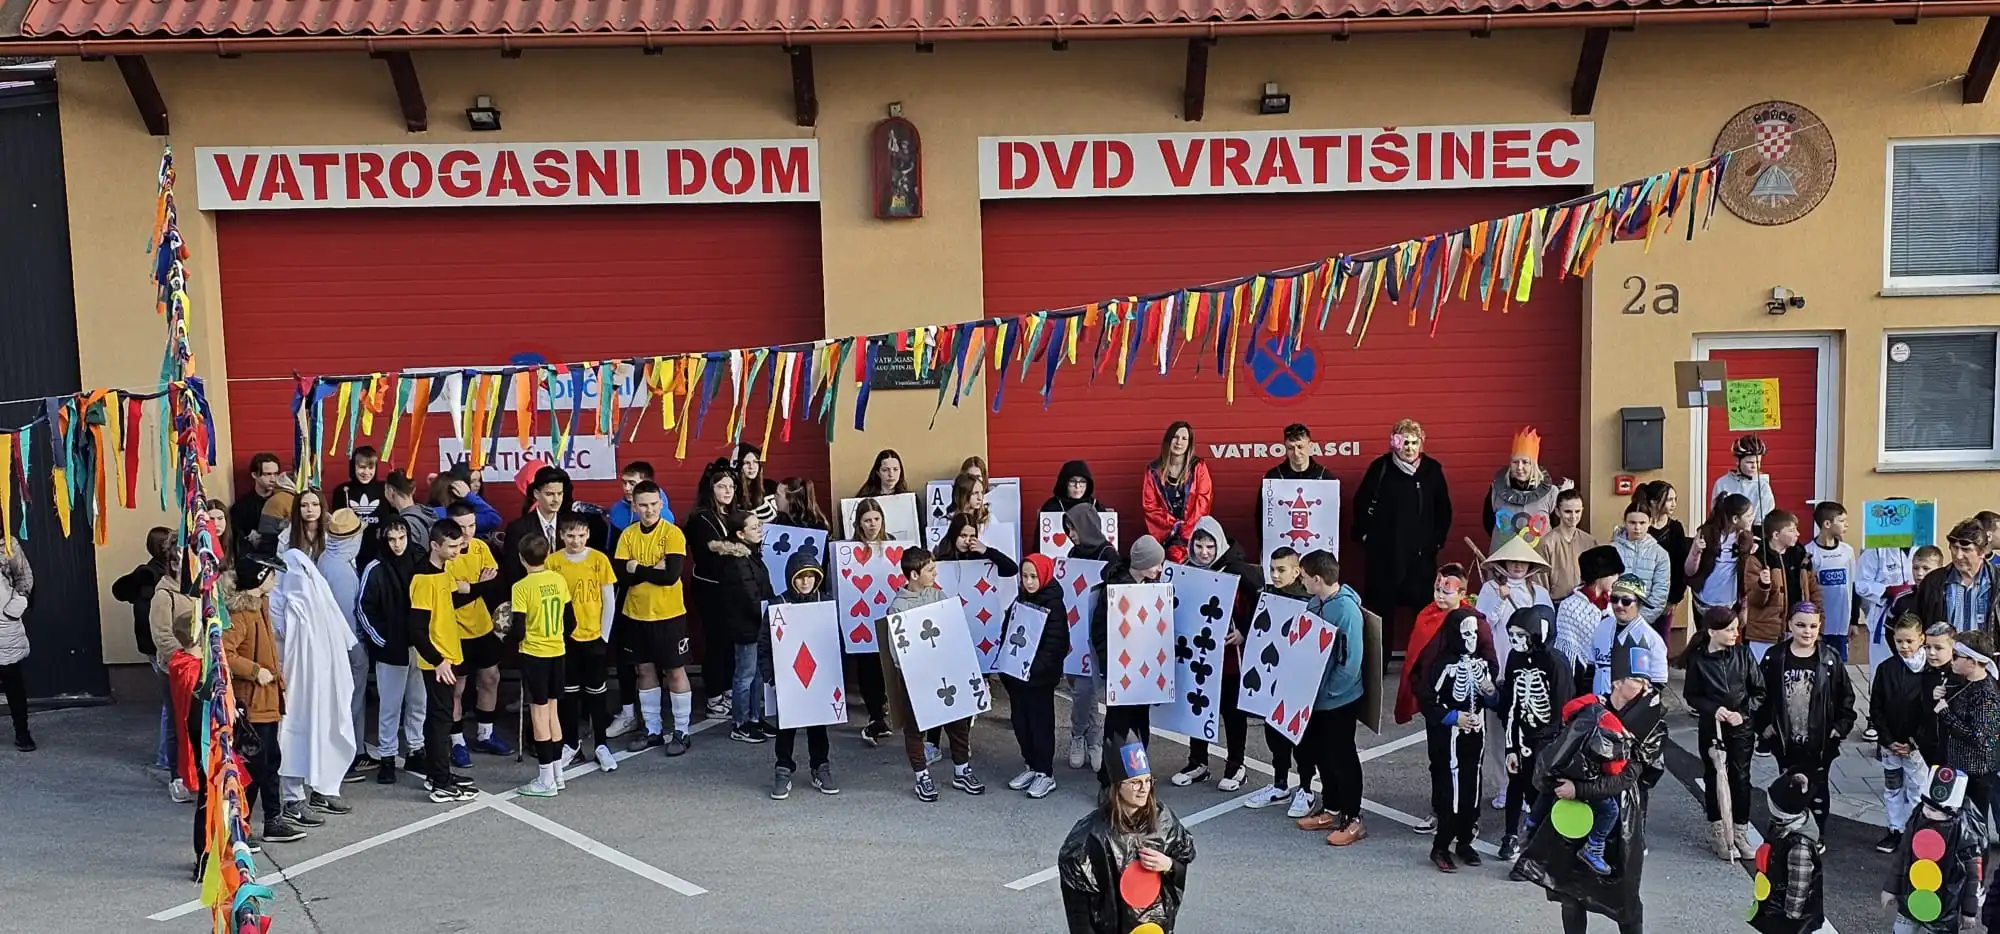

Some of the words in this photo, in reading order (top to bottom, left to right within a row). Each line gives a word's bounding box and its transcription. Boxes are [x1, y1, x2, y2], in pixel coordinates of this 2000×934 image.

[997, 140, 1135, 190] DVD
[1157, 126, 1581, 187] VRATIŠINEC
[212, 149, 641, 201] VATROGASNI
[667, 146, 810, 196] DOM
[1622, 275, 1679, 315] 2a
[1210, 441, 1360, 459] VATROASCI
[931, 487, 944, 506] A
[930, 527, 941, 542] 3
[1042, 518, 1051, 533] 8
[1106, 518, 1115, 533] 8
[839, 545, 852, 566] 9
[983, 562, 994, 578] 7
[1055, 560, 1066, 579] 3
[1164, 566, 1174, 583] 9
[1258, 594, 1267, 610] 5
[541, 597, 561, 637] 10
[771, 607, 788, 626] A
[891, 614, 906, 635] 2
[830, 701, 845, 720] A
